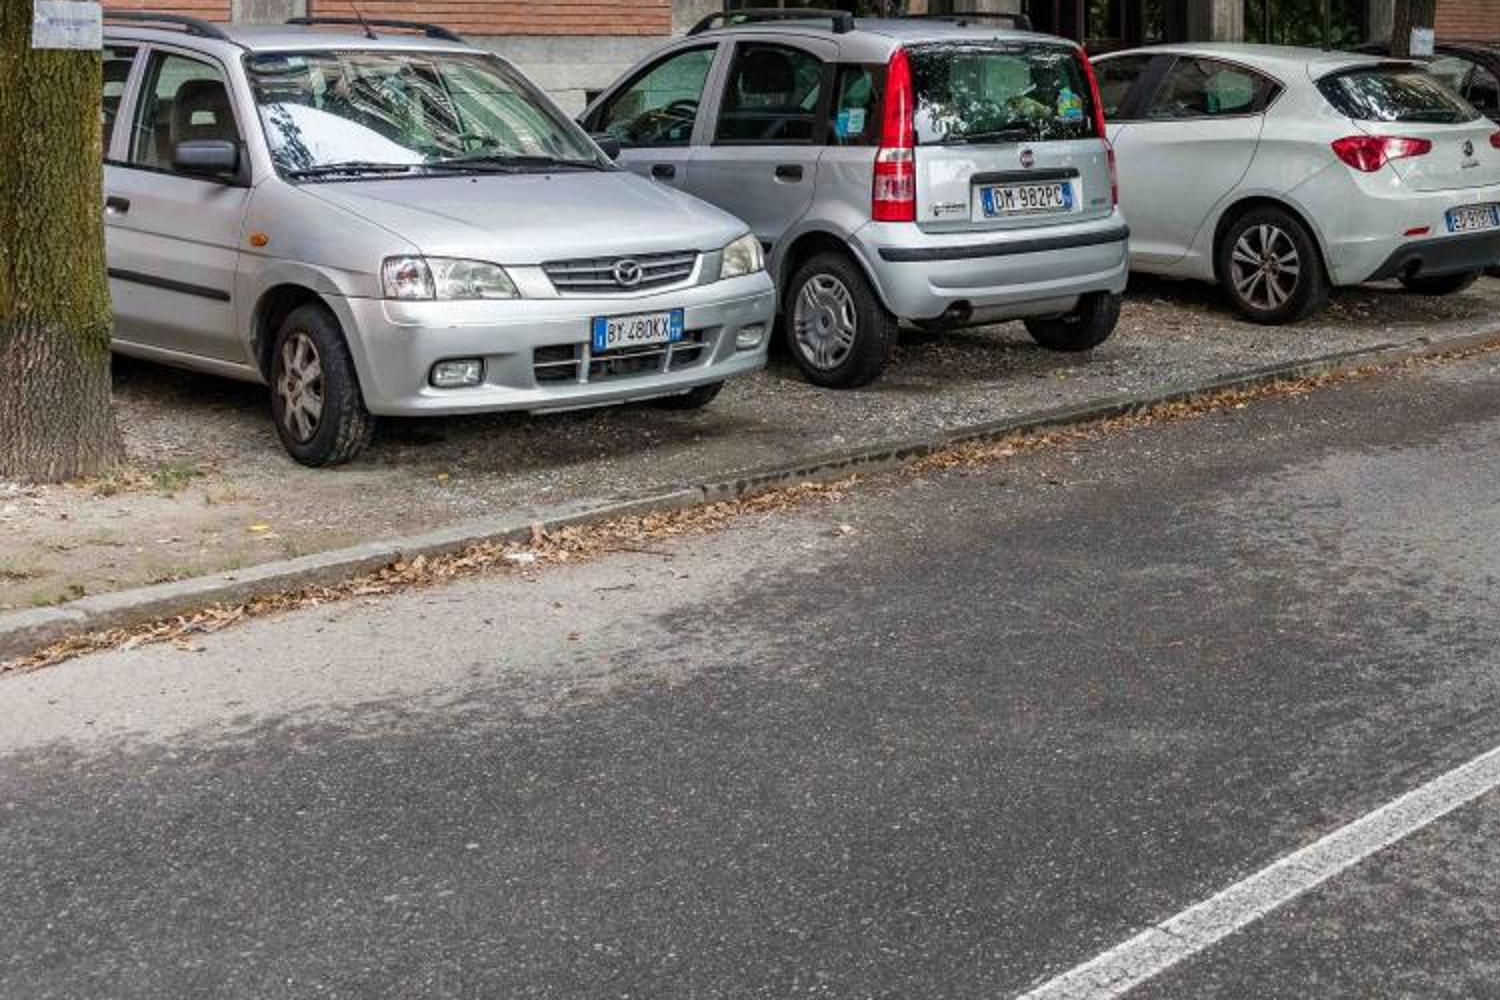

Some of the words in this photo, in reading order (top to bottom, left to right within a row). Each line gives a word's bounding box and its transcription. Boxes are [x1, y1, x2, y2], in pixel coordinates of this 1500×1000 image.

[994, 189, 1015, 210] DM
[1020, 186, 1063, 208] 982PC
[608, 322, 624, 343] BY
[628, 317, 669, 340] 480KX
